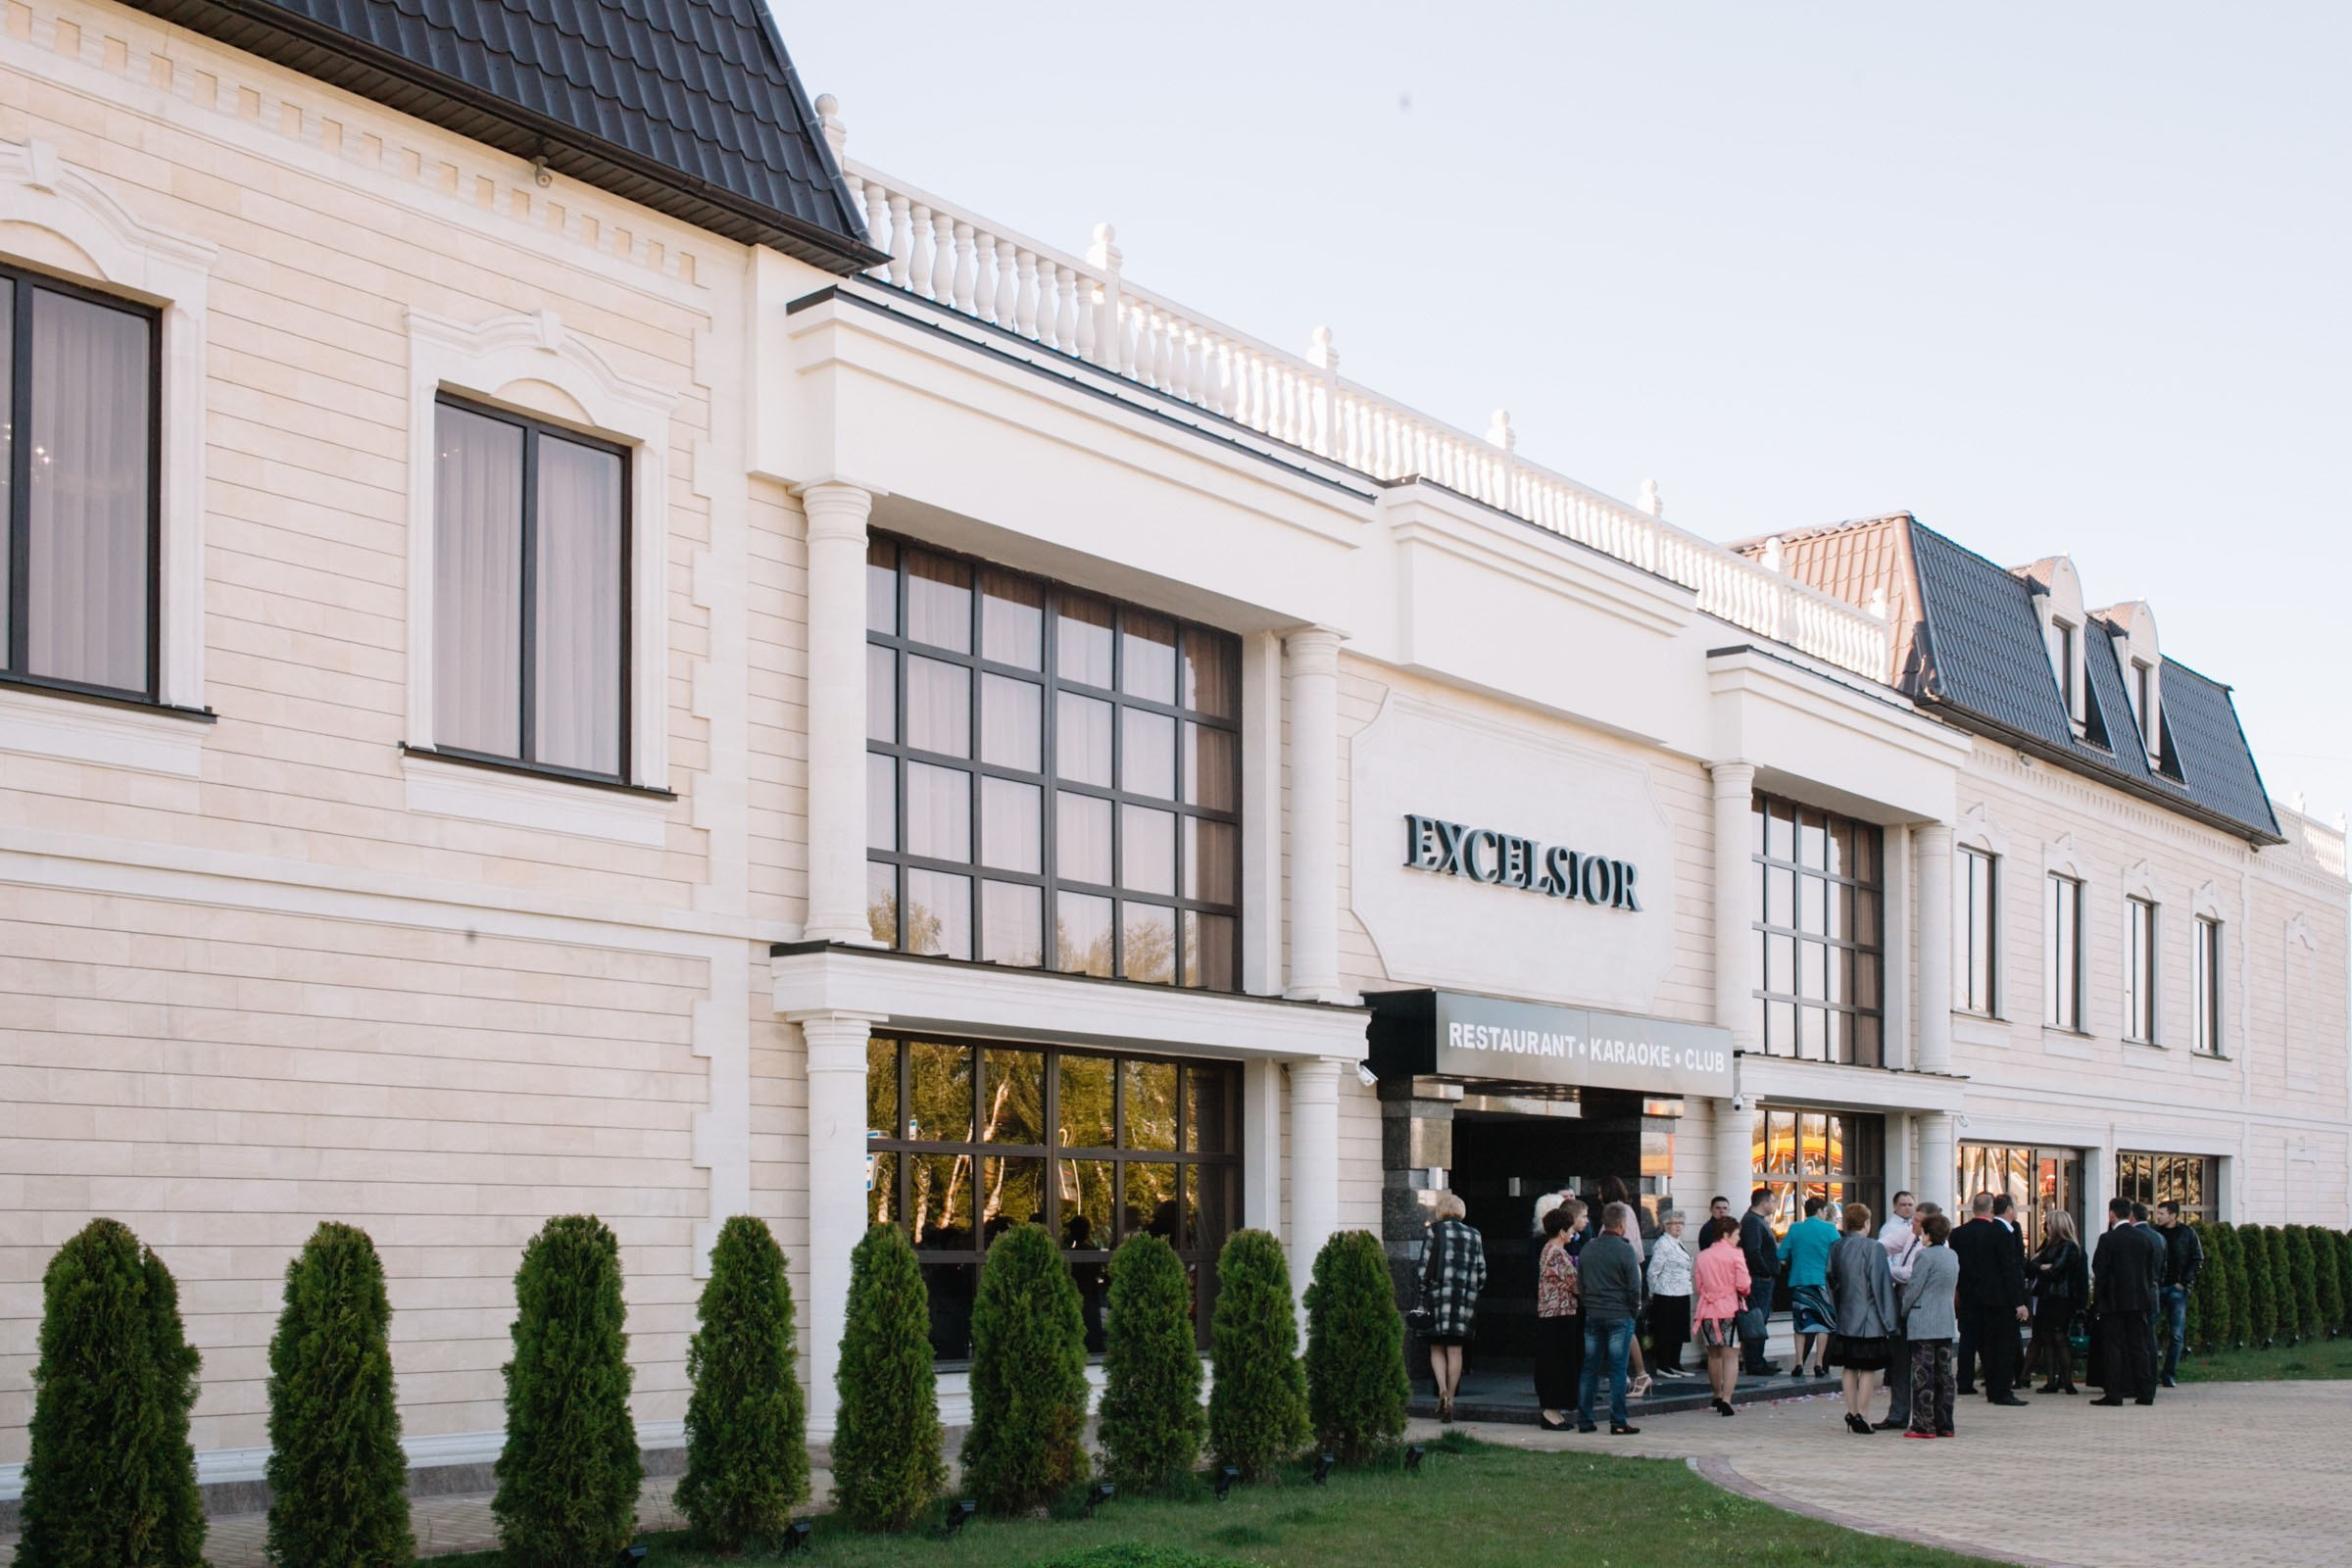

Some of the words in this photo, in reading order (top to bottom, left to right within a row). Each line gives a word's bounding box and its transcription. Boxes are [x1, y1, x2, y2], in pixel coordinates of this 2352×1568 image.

[1403, 813, 1643, 911] EXCELSIOR
[1448, 1022, 1577, 1057] RESTAURANT
[1590, 1038, 1671, 1067] KARAOKE
[1685, 1048, 1725, 1073] CLUB
